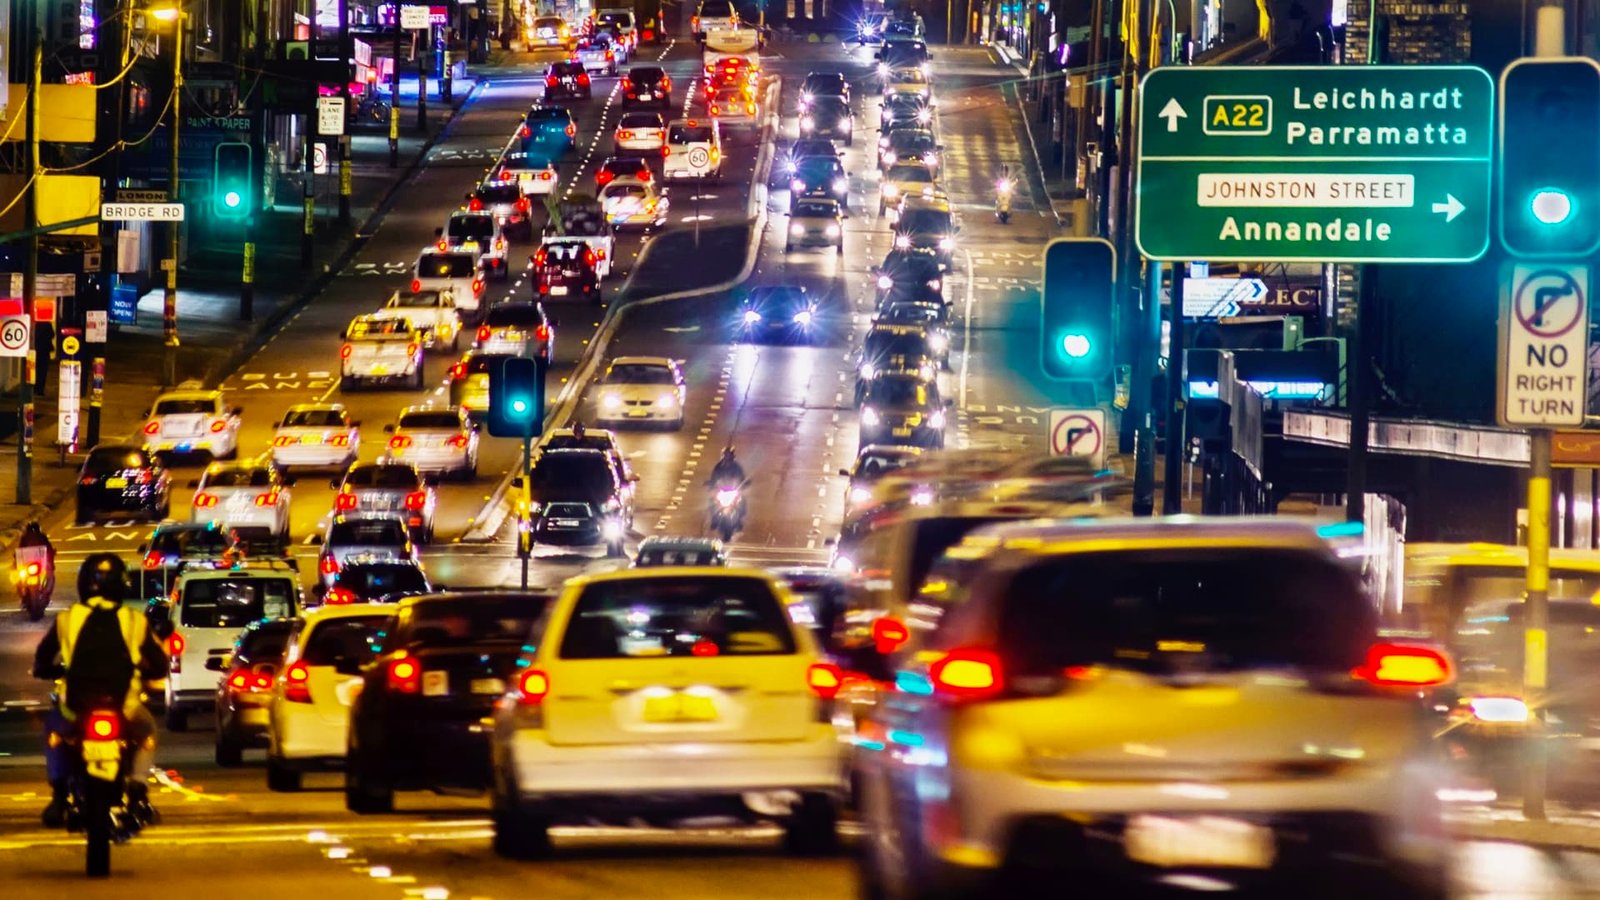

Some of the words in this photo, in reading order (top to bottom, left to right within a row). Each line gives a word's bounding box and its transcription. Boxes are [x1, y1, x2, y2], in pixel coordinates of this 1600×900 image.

[1293, 87, 1463, 110] Leichhardt
[222, 118, 250, 130] PAPER
[1212, 105, 1264, 127] A22
[1287, 122, 1468, 145] Parramatta
[692, 152, 706, 163] 60
[1206, 181, 1317, 199] JOHNSTON
[1329, 181, 1407, 199] STREET
[106, 207, 155, 217] BRIDGE
[162, 207, 180, 217] RD
[1219, 216, 1392, 241] Annandale
[114, 300, 132, 308] NOW
[5, 328, 23, 341] 60
[1526, 344, 1569, 368] NO
[1516, 376, 1577, 392] RIGHT
[1519, 398, 1574, 416] TURN
